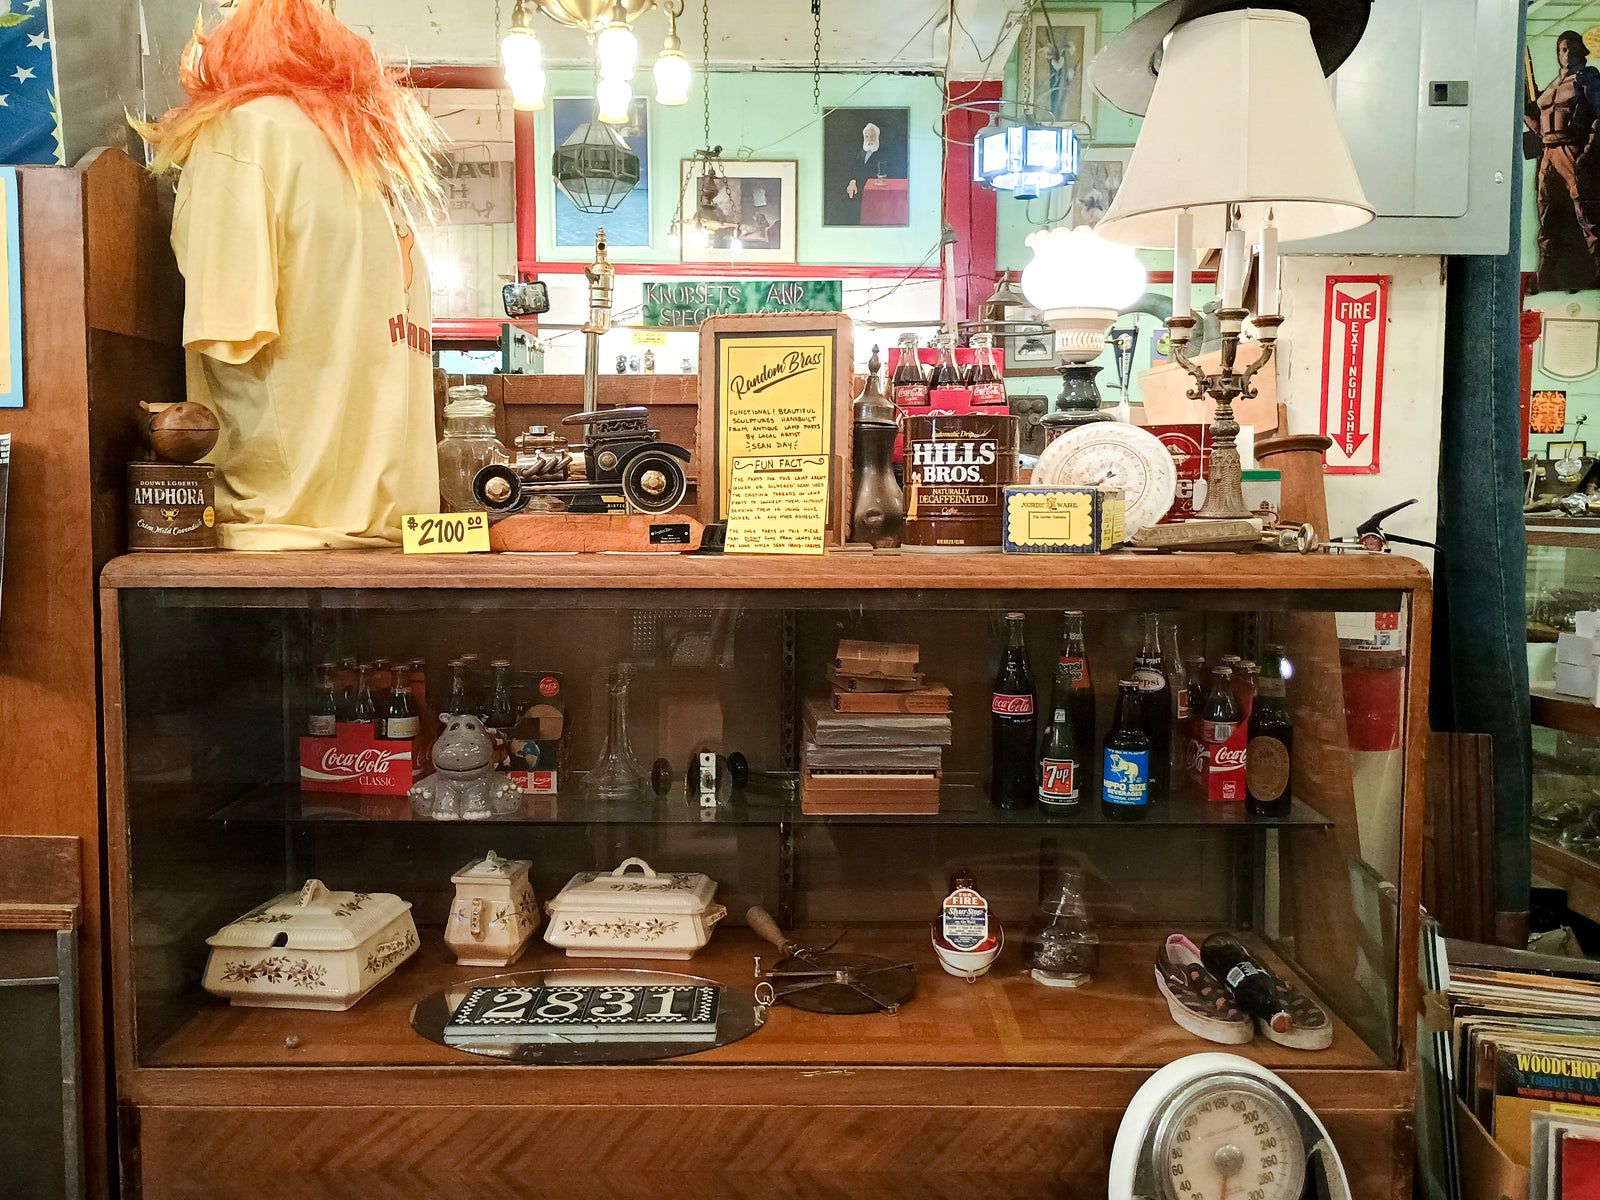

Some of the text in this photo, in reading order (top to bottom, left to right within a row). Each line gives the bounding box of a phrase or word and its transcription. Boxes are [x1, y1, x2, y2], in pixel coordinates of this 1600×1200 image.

[647, 283, 804, 305] KNOBSETS AND
[1341, 302, 1371, 319] FIRE
[730, 351, 822, 400] Random Brass
[1346, 321, 1359, 454] EXTINGUISHER
[776, 442, 792, 450] DAY
[912, 442, 996, 465] HILLS
[755, 458, 802, 469] FUN FACT
[923, 466, 984, 483] BROS.
[134, 488, 205, 505] AMPHORA
[919, 495, 989, 504] DECAFFEINATED
[992, 696, 1030, 712] Coca-Cola
[322, 747, 392, 774] Coca-Cola
[359, 776, 395, 787] CLASSIC
[1128, 783, 1147, 791] SIZE
[1107, 788, 1143, 797] BEVERAGES
[952, 896, 979, 905] FIRE
[482, 990, 682, 1018] 2831
[1530, 1075, 1573, 1090] TRIBUTE
[1578, 1080, 1593, 1091] TO
[1231, 1100, 1246, 1113] 180
[1242, 1110, 1259, 1124] 200
[1252, 1122, 1269, 1136] 220
[1176, 1130, 1191, 1143] 100
[1260, 1137, 1277, 1150] 240
[1172, 1148, 1182, 1159] 80
[1260, 1154, 1278, 1168] 260
[1171, 1164, 1183, 1176] 60
[1258, 1171, 1274, 1185] 280
[1180, 1180, 1191, 1191] 40
